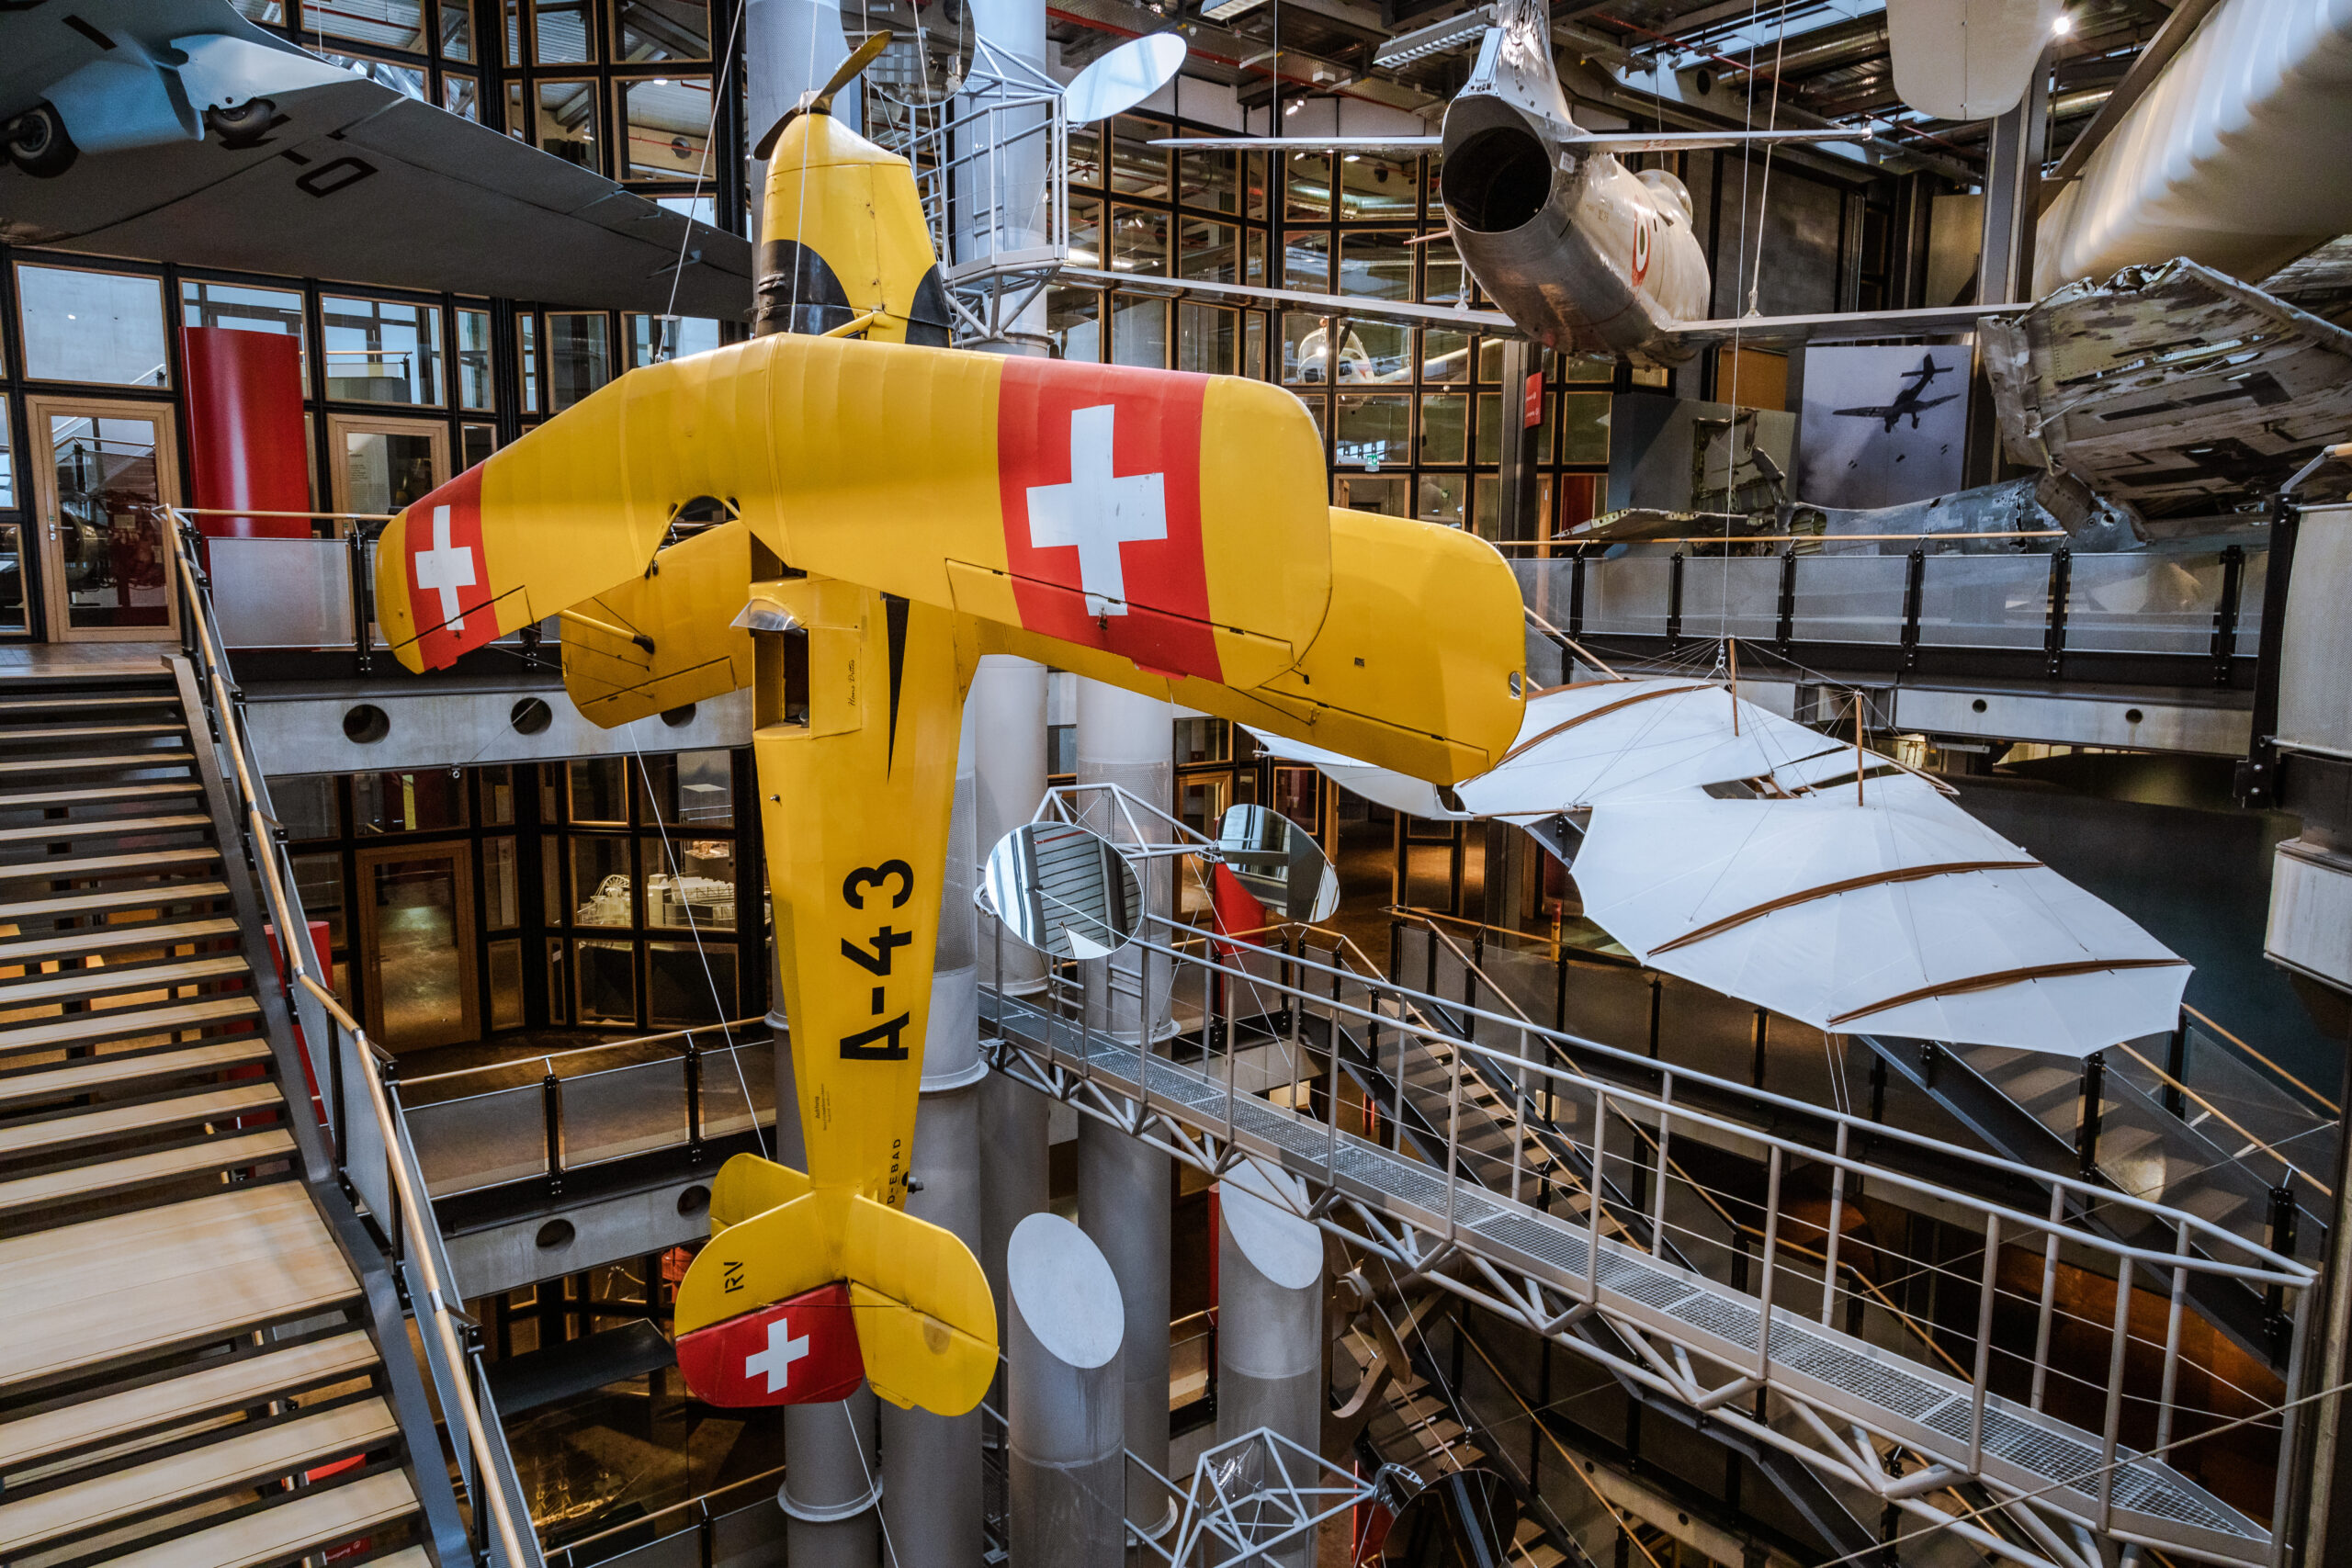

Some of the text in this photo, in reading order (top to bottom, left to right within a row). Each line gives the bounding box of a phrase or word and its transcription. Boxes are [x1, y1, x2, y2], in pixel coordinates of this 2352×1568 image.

[840, 859, 914, 1061] A-43
[887, 1138, 901, 1205] D-EBAD
[723, 1261, 744, 1293] RV
